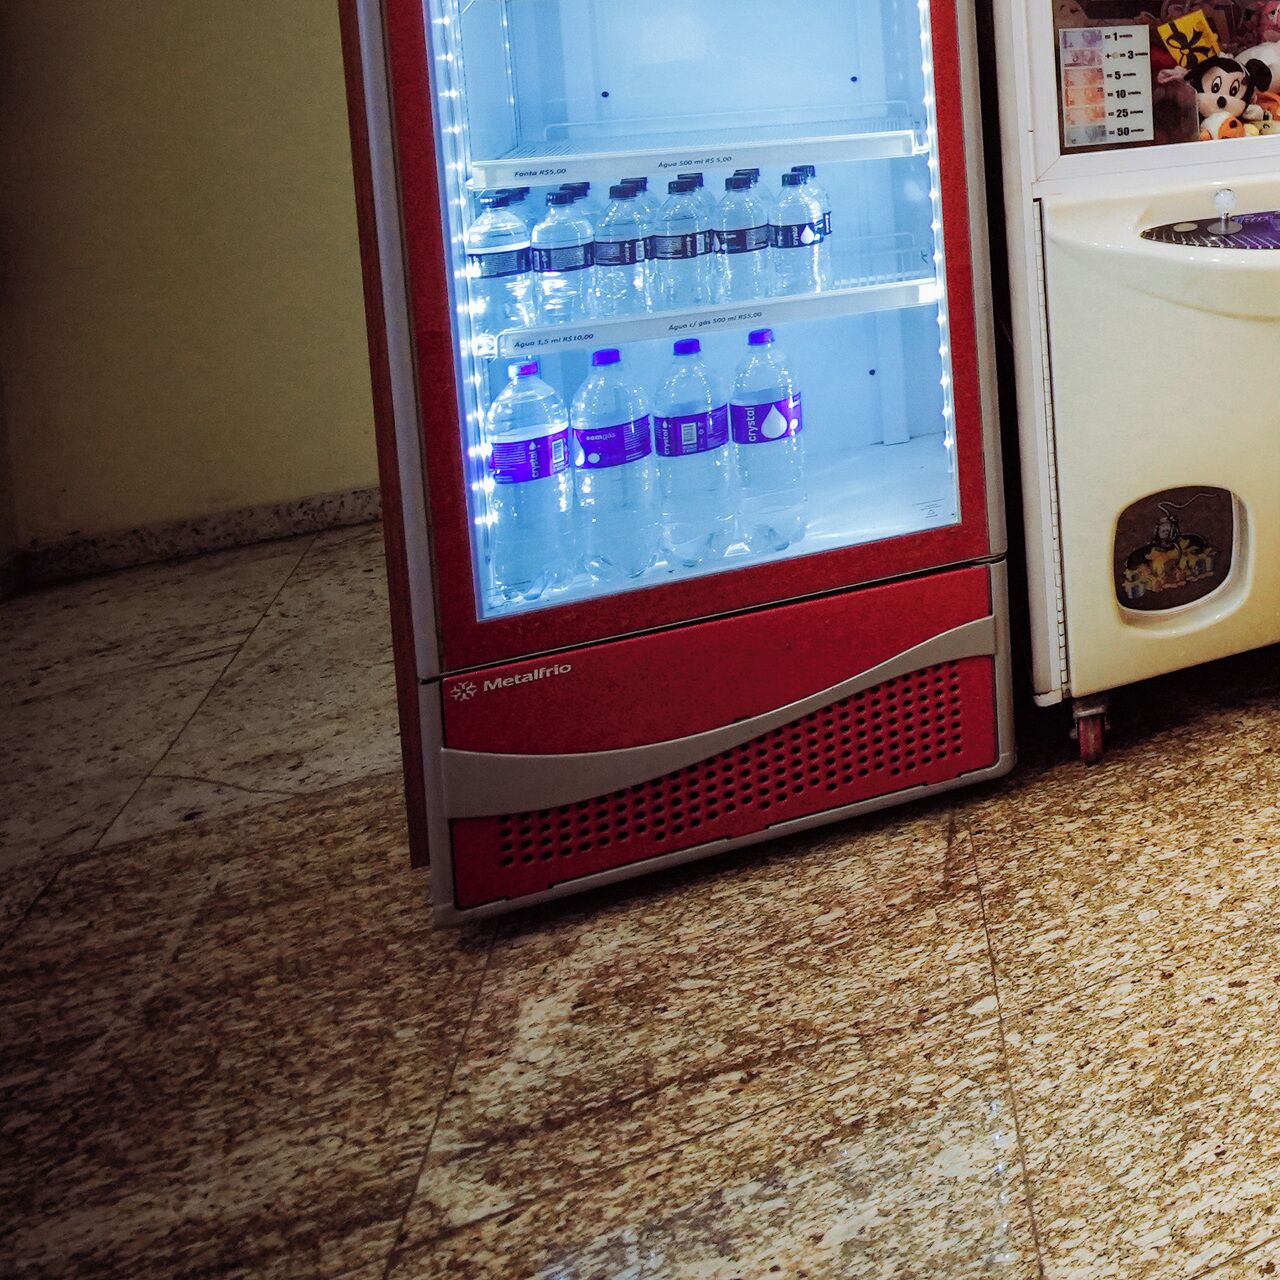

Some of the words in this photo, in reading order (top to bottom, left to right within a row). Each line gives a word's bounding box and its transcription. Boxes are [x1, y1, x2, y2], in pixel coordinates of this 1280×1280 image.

[1127, 50, 1134, 59] 3
[1114, 71, 1121, 80] 5
[1115, 90, 1127, 99] 10
[1116, 108, 1129, 118] 25
[1117, 127, 1130, 137] 50
[678, 159, 693, 167] 500
[514, 169, 537, 177] Fanta
[744, 406, 758, 442] crystal
[661, 428, 671, 456] crystal
[527, 450, 540, 478] crystal
[483, 664, 572, 692] Metalfrio
